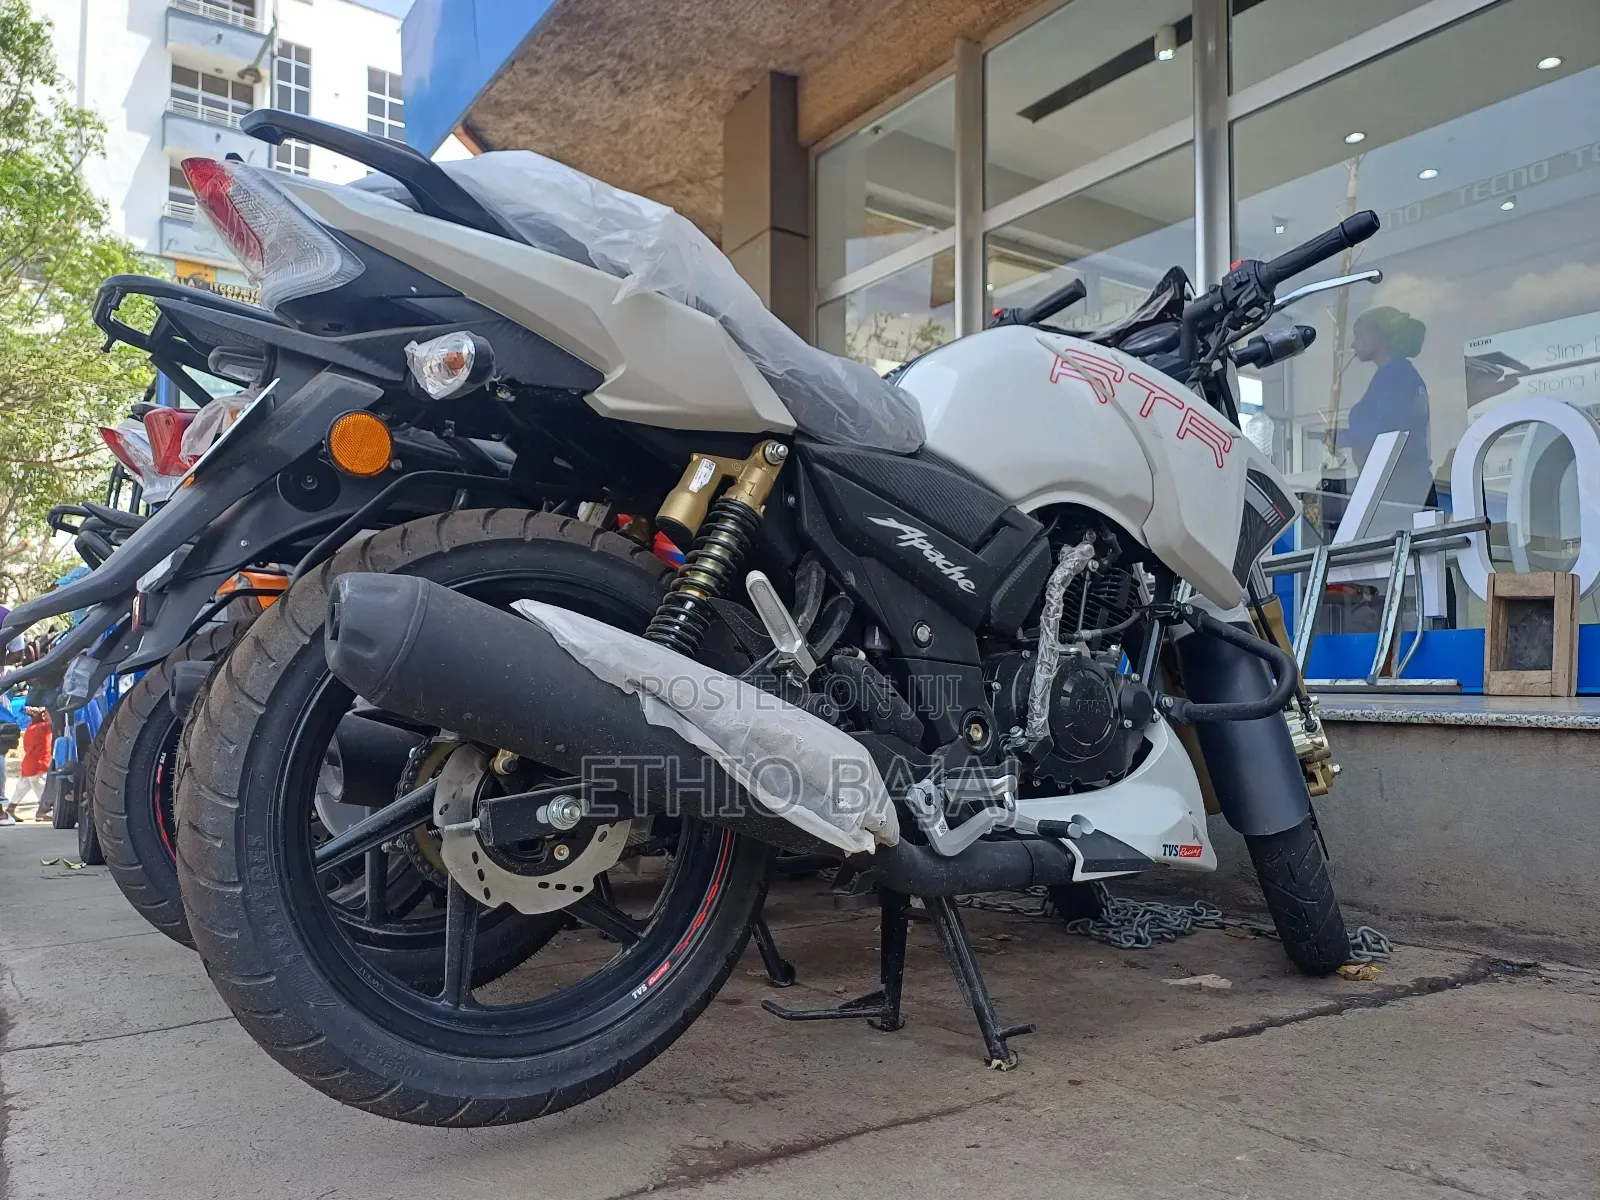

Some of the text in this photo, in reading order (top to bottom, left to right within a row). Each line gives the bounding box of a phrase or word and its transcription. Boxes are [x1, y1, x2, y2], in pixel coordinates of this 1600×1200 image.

[1454, 160, 1549, 206] TECNO
[1469, 338, 1492, 348] TECNO
[1545, 343, 1584, 361] Slim
[1527, 373, 1585, 395] Strong
[1050, 348, 1232, 469] RTR
[866, 516, 977, 594] Apache
[1162, 844, 1202, 857] TVS Racing
[631, 983, 648, 999] TVS
